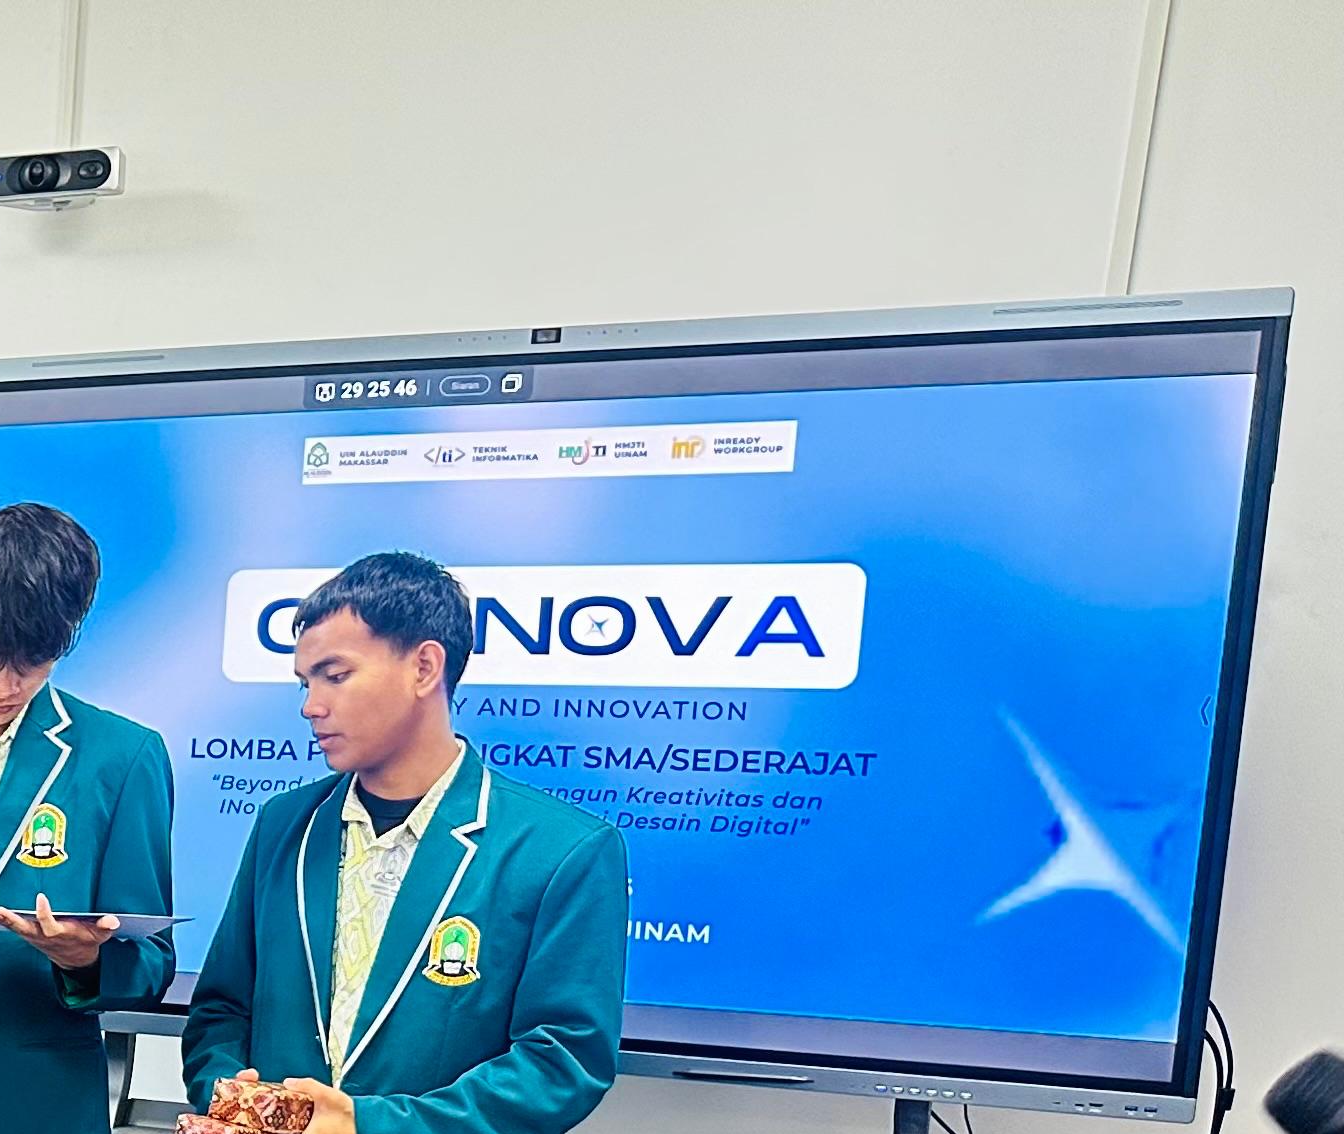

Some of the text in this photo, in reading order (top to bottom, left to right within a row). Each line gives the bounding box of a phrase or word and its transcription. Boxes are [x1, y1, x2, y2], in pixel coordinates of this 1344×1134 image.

[340, 379, 418, 399] 29 25 46
[713, 436, 761, 445] INREADY
[339, 449, 408, 458] UIN ALAUDDIN
[472, 446, 508, 454] TEKNIK
[614, 450, 648, 459] UINAM
[713, 445, 783, 455] WORKGROUP
[339, 457, 389, 466] MAKASSAR
[472, 453, 539, 463] INFORMATIKA
[257, 595, 825, 658] CNOVA
[477, 697, 541, 718] AND
[552, 697, 748, 722] INNOVATION
[190, 737, 298, 762] LOMBA
[583, 743, 878, 777] SMA/SEDERAJAT
[625, 785, 764, 809] Kreativitas
[772, 790, 823, 812] dan
[616, 811, 701, 833] Desain
